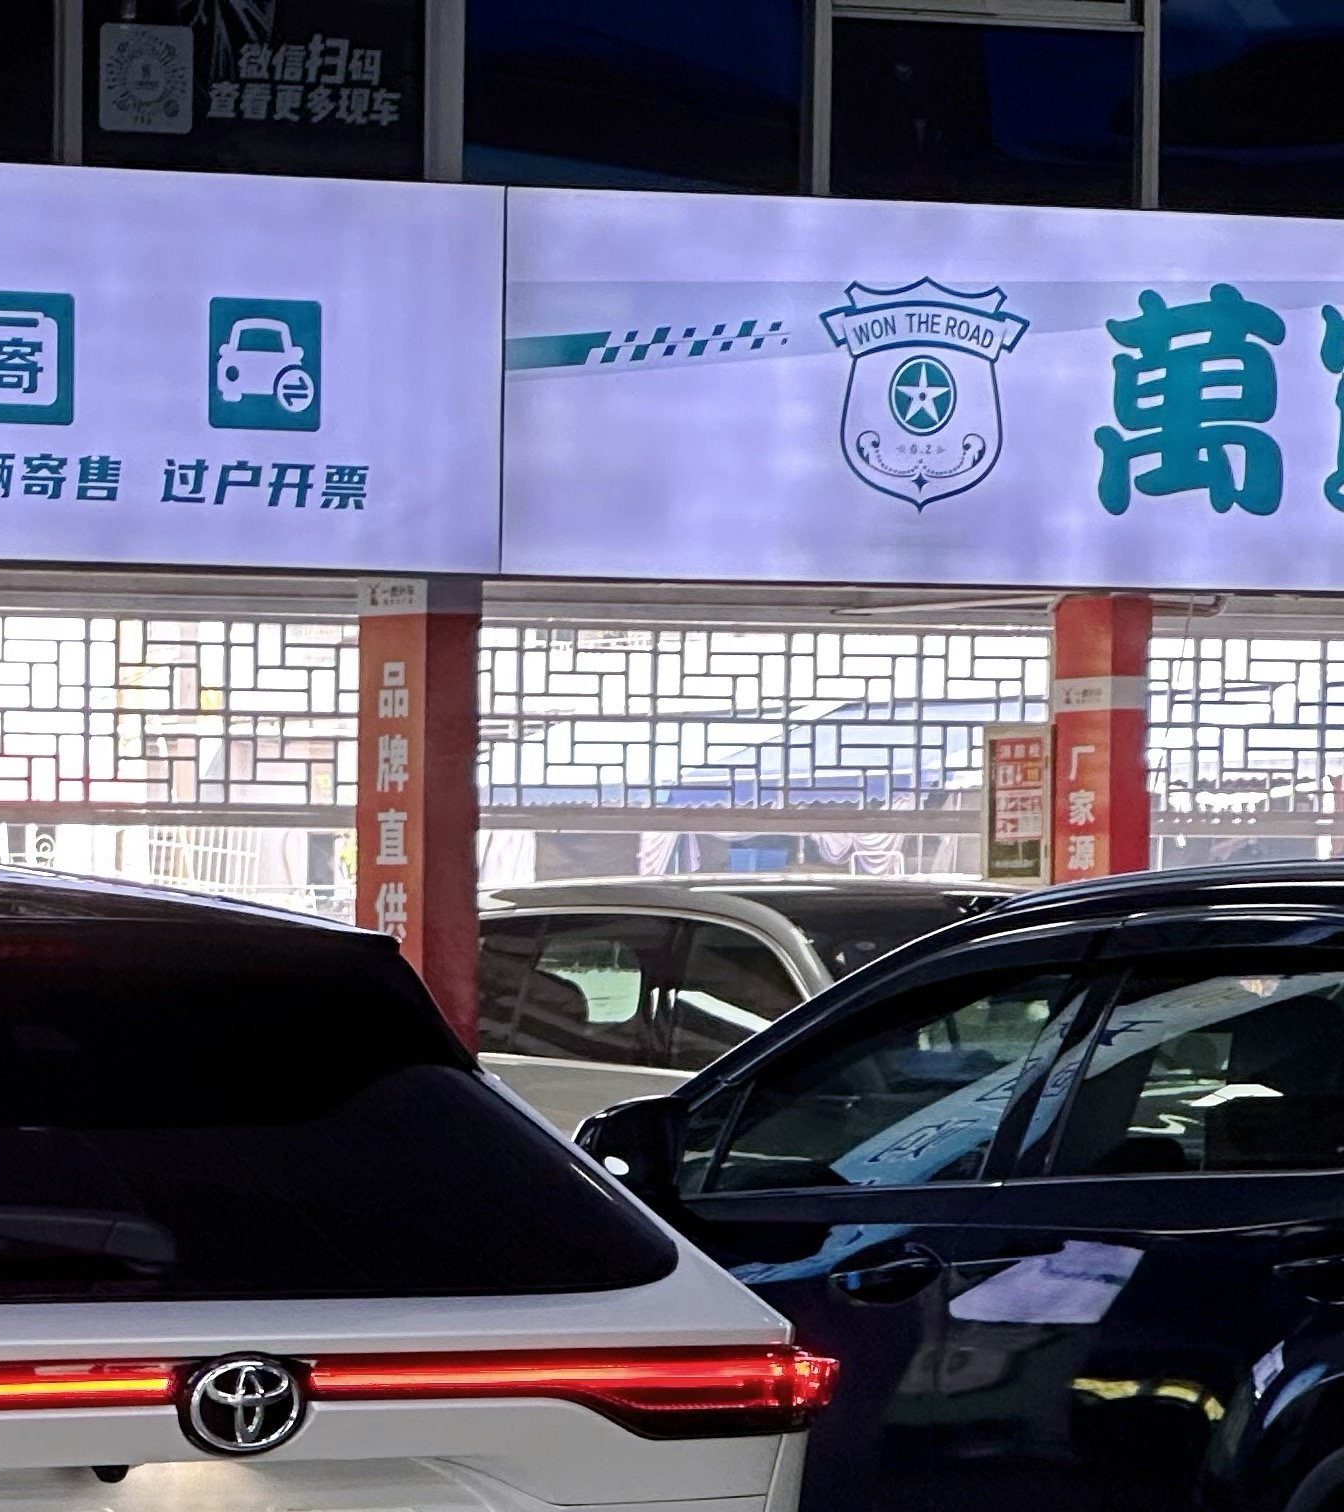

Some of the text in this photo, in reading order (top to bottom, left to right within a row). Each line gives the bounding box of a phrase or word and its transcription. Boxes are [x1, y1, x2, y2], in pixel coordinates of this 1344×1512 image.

[238, 33, 382, 86] 微信扫码
[853, 313, 995, 349] WON THE ROAD
[161, 458, 371, 511] 过户开票
[375, 661, 409, 942] 品牌直供
[1068, 745, 1096, 882] 厂家源
